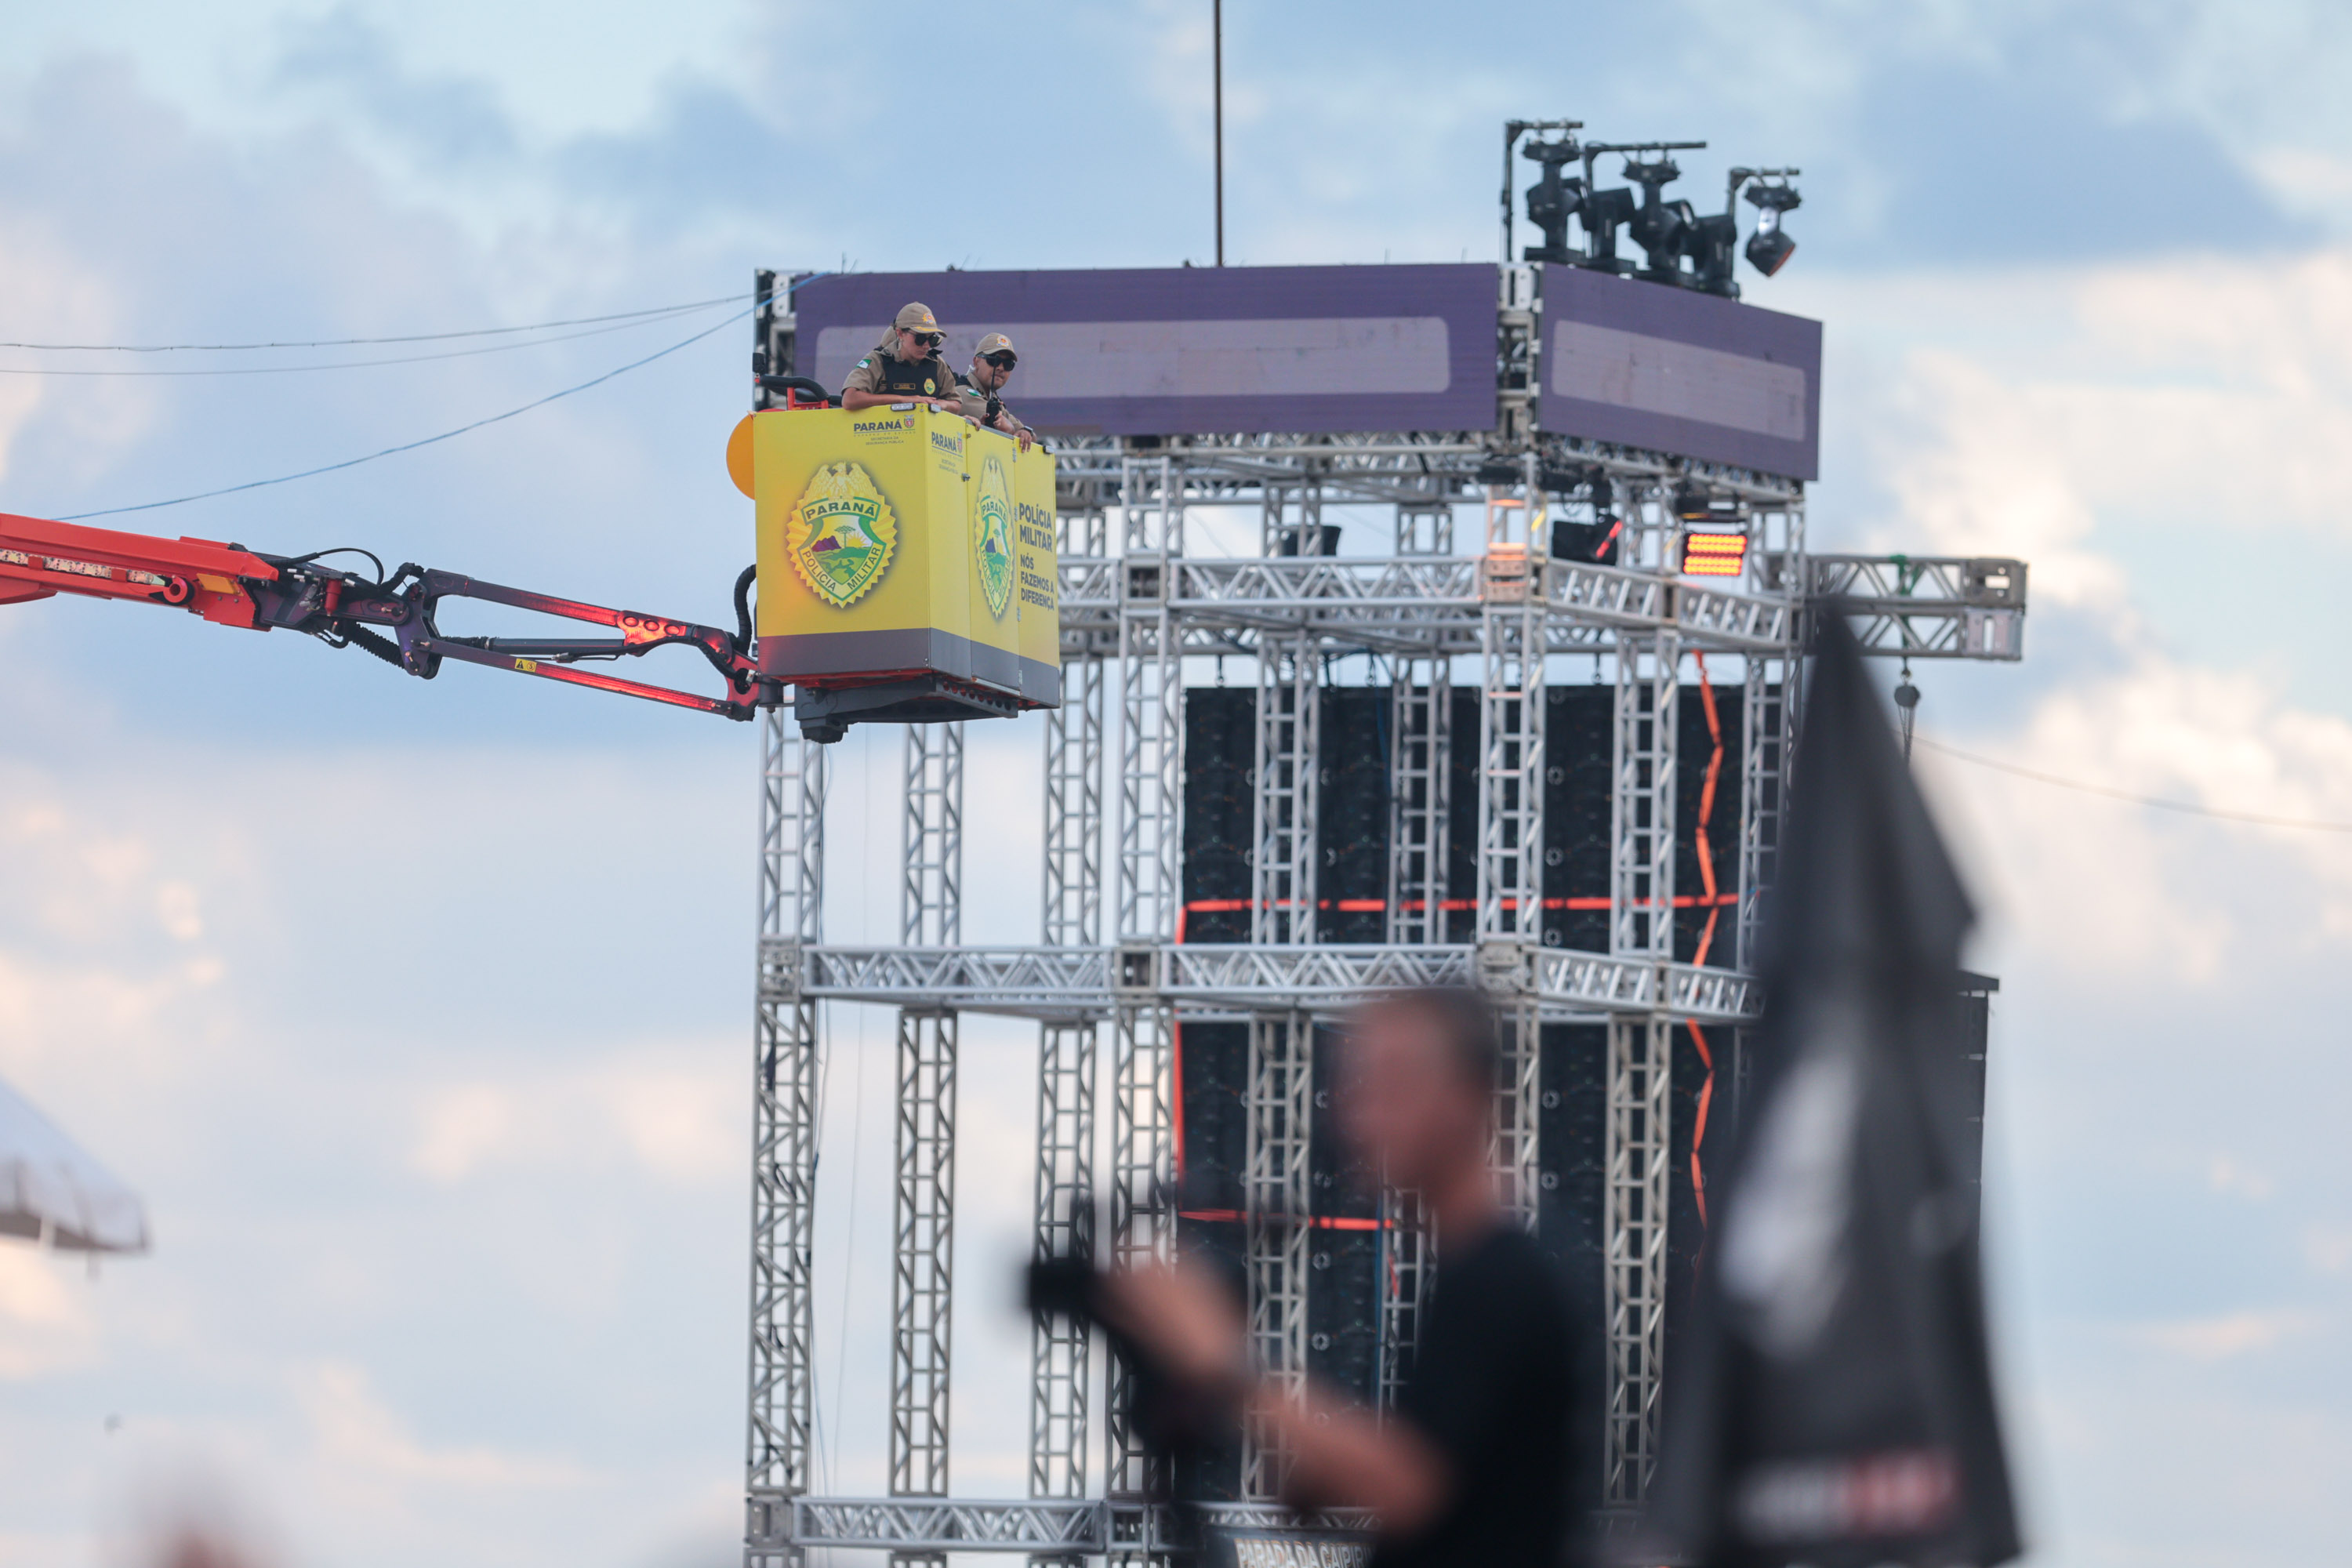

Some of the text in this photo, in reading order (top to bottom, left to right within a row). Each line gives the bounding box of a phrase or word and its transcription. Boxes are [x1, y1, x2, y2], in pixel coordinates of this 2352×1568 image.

[854, 419, 902, 431] PARANÁ
[931, 431, 956, 452] PARANÁ
[805, 502, 875, 519] PARANÁ
[1019, 503, 1052, 531] POLÍCIA
[1019, 524, 1052, 552] MILITAR
[803, 547, 880, 591] POLÍCIA MILITAR
[1020, 553, 1034, 570] NÓS
[1021, 571, 1054, 594] FAZEMOS A
[1021, 587, 1054, 611] DIFERENÇA
[1234, 1538, 1295, 1568] PARADA
[1294, 1541, 1320, 1568] DA
